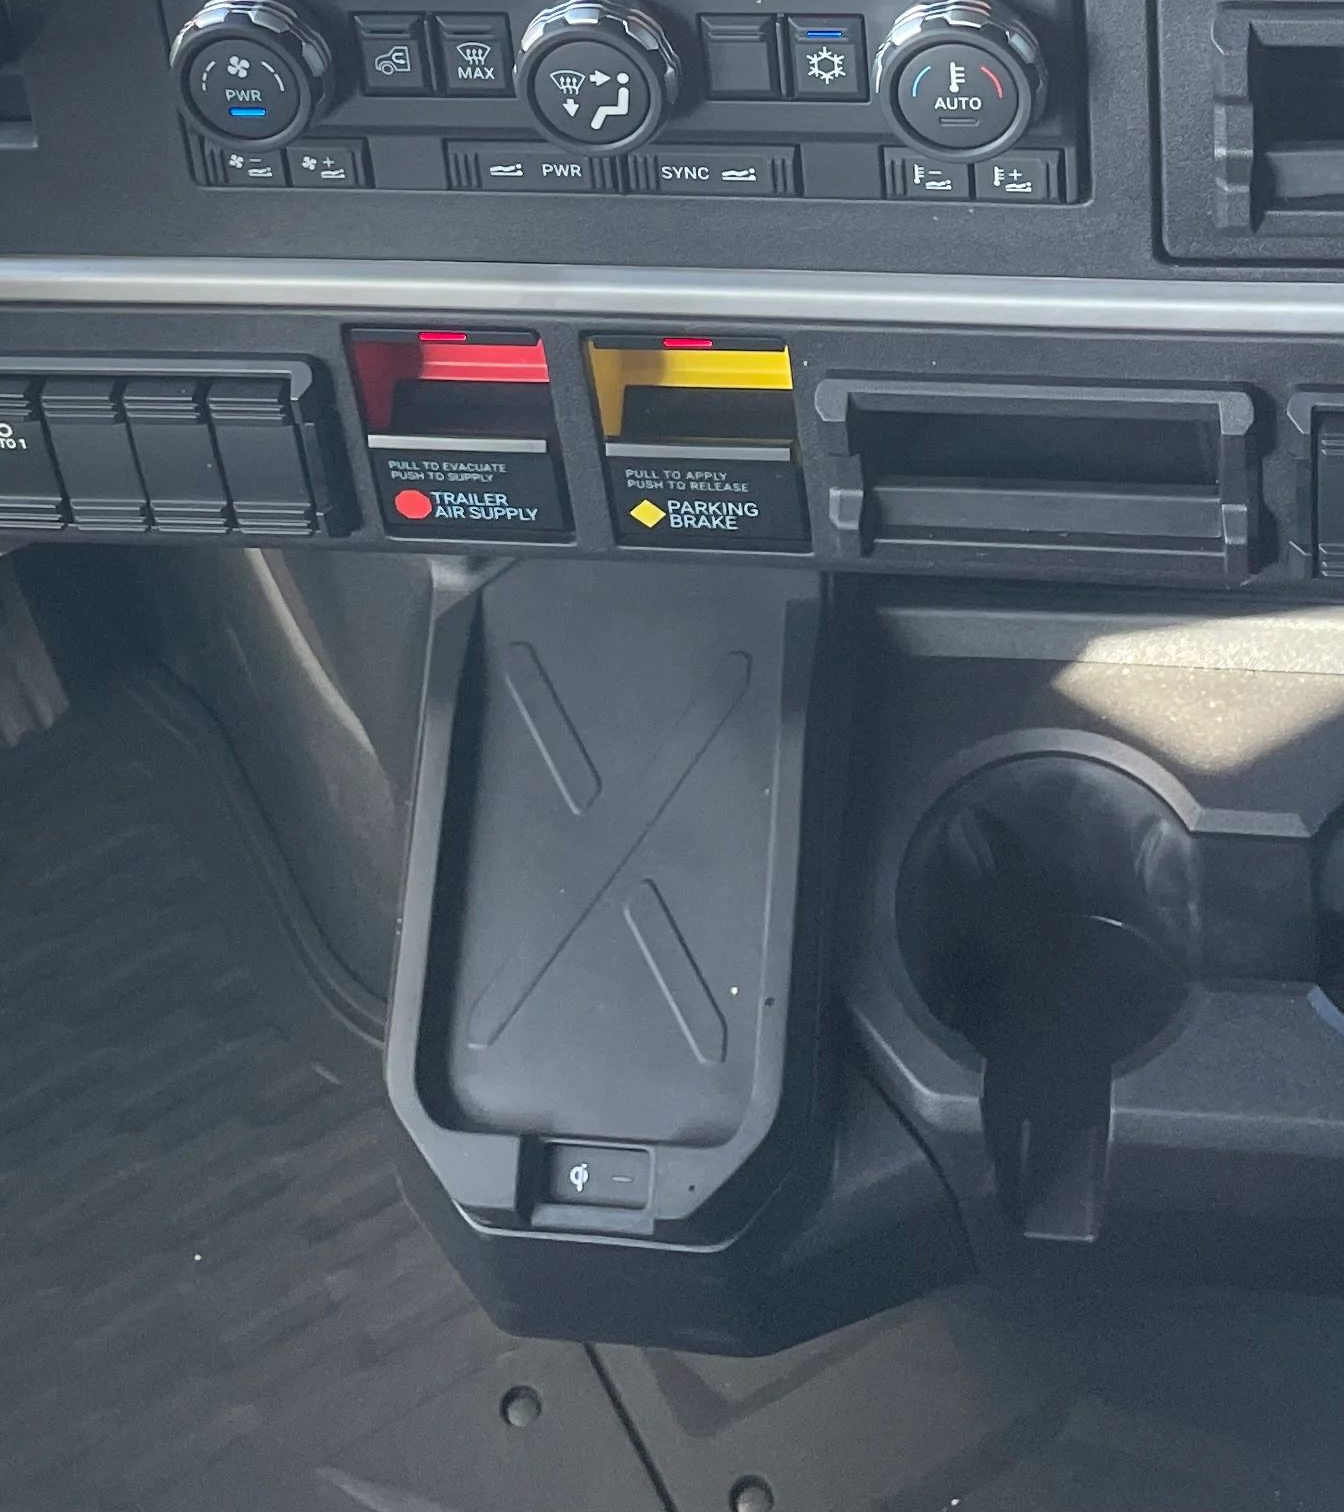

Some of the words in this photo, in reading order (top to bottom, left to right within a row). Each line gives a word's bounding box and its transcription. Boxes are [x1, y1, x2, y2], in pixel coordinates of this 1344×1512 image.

[458, 66, 495, 79] MAX
[225, 89, 263, 102] PWR
[934, 97, 983, 111] AUTO
[541, 164, 583, 177] PWR
[661, 166, 709, 180] SYNC
[19, 439, 26, 449] 1
[388, 461, 421, 472] PULL
[423, 462, 439, 472] TO
[442, 462, 507, 473] EVACUATE
[391, 471, 426, 481] PUSH
[429, 471, 445, 482] TO
[448, 471, 494, 482] SUPPLY
[625, 469, 658, 480] PULL
[662, 470, 681, 480] TO
[683, 470, 727, 481] APPLY
[627, 480, 664, 490] PUSH
[668, 481, 685, 491] TO
[689, 482, 748, 493] RELEASE
[431, 491, 508, 506] TRAILER
[435, 505, 467, 519] AIR
[470, 506, 538, 521] SUPPLY
[668, 500, 759, 518] PARKING
[670, 514, 738, 530] BRAKE
